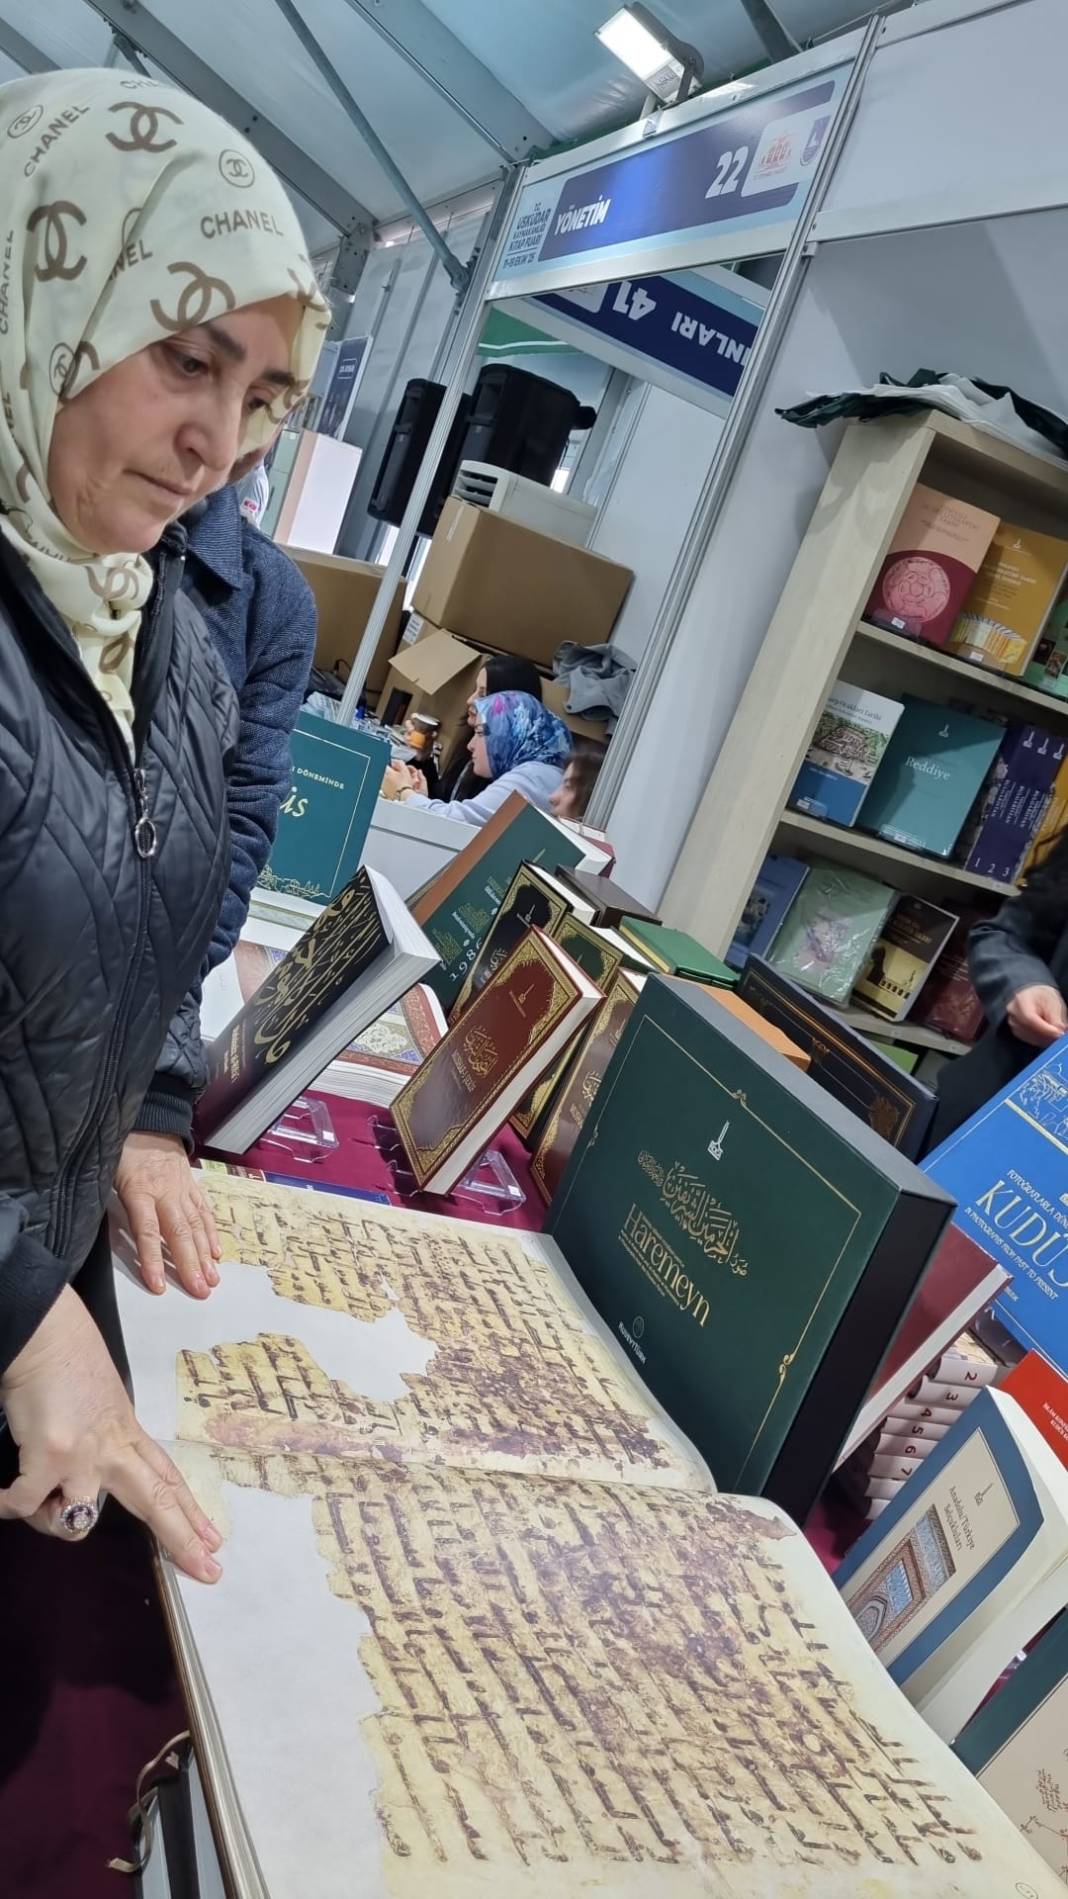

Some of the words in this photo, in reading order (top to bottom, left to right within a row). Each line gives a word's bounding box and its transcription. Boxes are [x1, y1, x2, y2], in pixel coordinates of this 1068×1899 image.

[24, 104, 90, 178] CHANEL
[705, 146, 749, 199] 22
[200, 208, 285, 240] CHANEL
[554, 195, 611, 236] YÖNETİM
[107, 239, 153, 281] NEL
[613, 280, 656, 321] 41
[905, 756, 951, 781] Reddiye
[297, 767, 345, 790] DÖNEMİNDE
[974, 857, 981, 868] 1
[987, 863, 996, 873] 2
[1002, 866, 1010, 877] 3
[623, 1203, 711, 1327] Haremeyn
[965, 1371, 977, 1382] 2
[945, 1392, 958, 1401] 3
[922, 1407, 932, 1418] 4
[912, 1425, 923, 1435] 5
[905, 1445, 916, 1454] 6
[901, 1467, 912, 1477] 7
